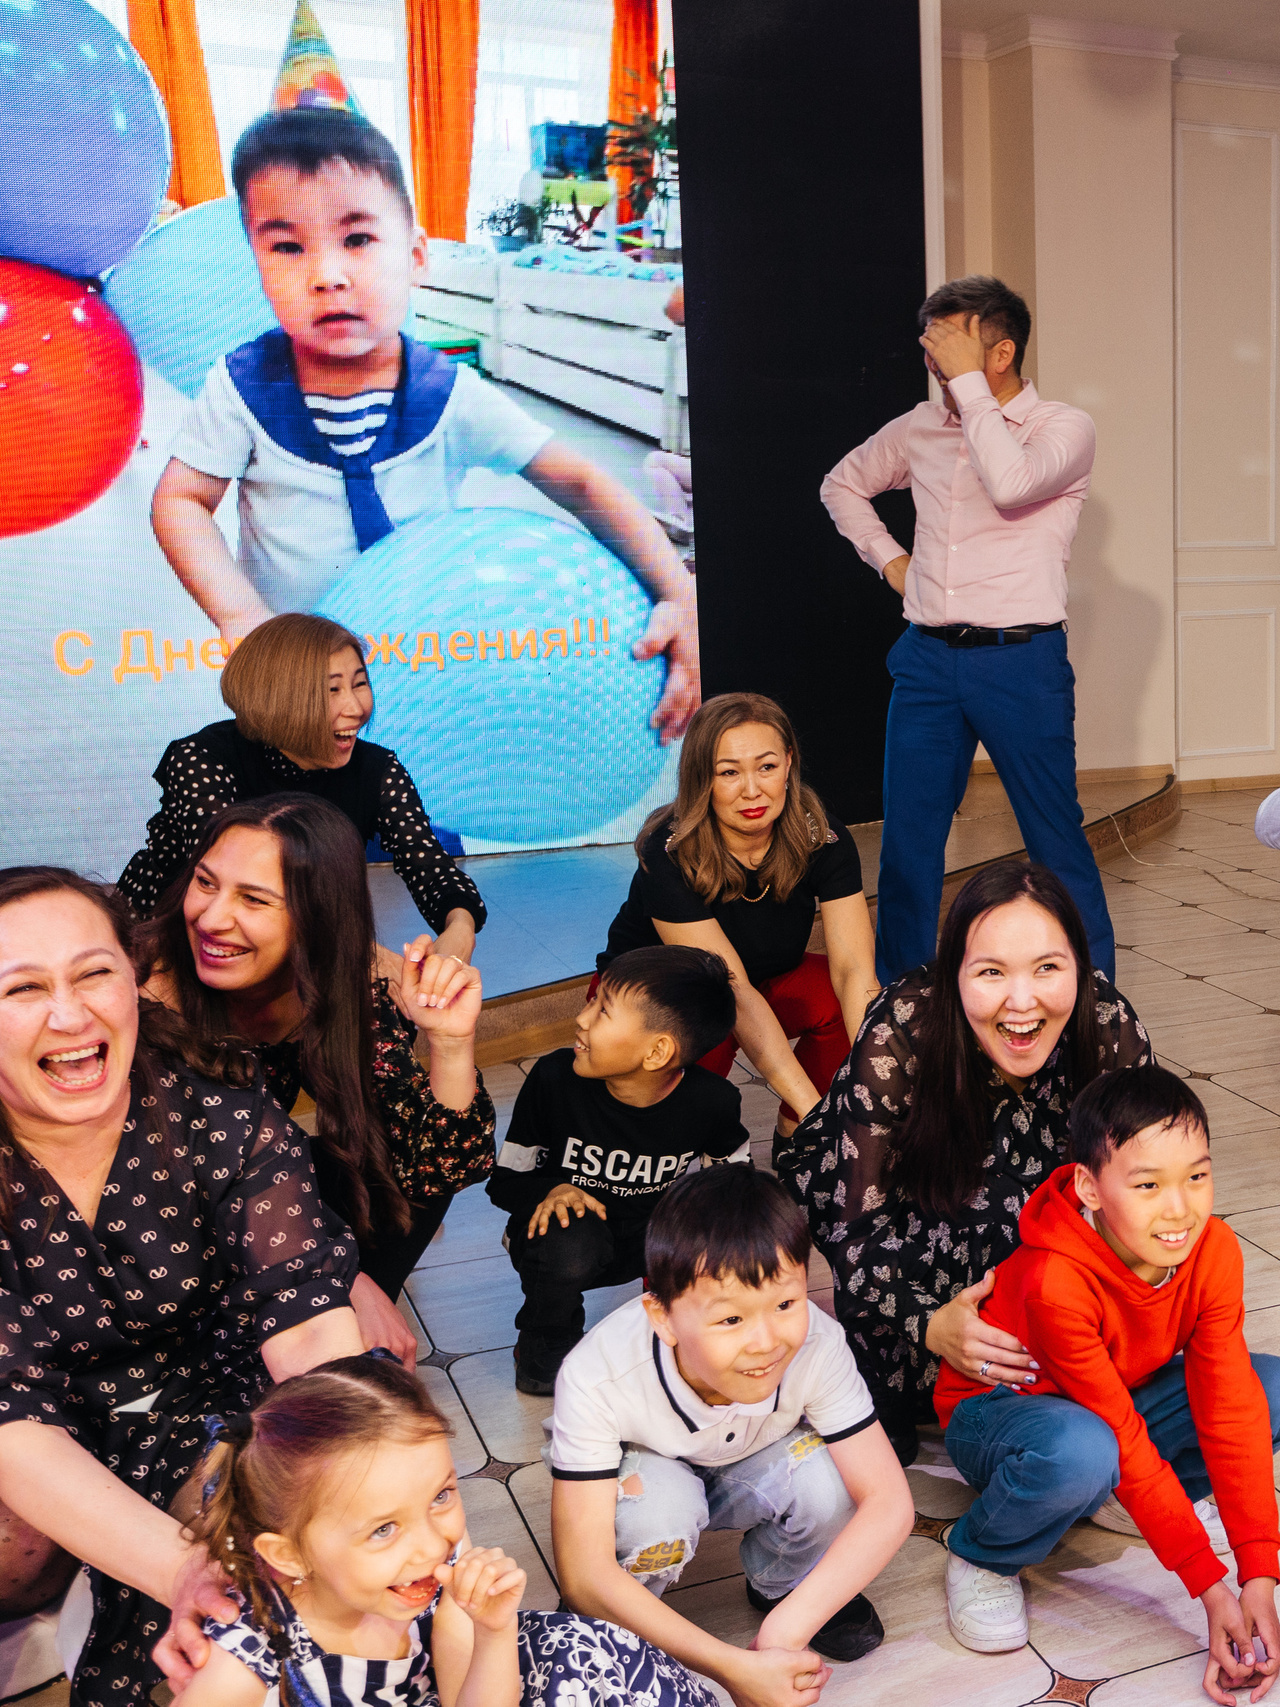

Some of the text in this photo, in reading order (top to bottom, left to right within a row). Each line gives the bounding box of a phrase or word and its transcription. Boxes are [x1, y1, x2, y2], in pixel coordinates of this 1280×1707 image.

[54, 617, 610, 684] С Дне ждения!!!
[561, 1136, 694, 1184] ESCAPE
[571, 1175, 609, 1190] FROM
